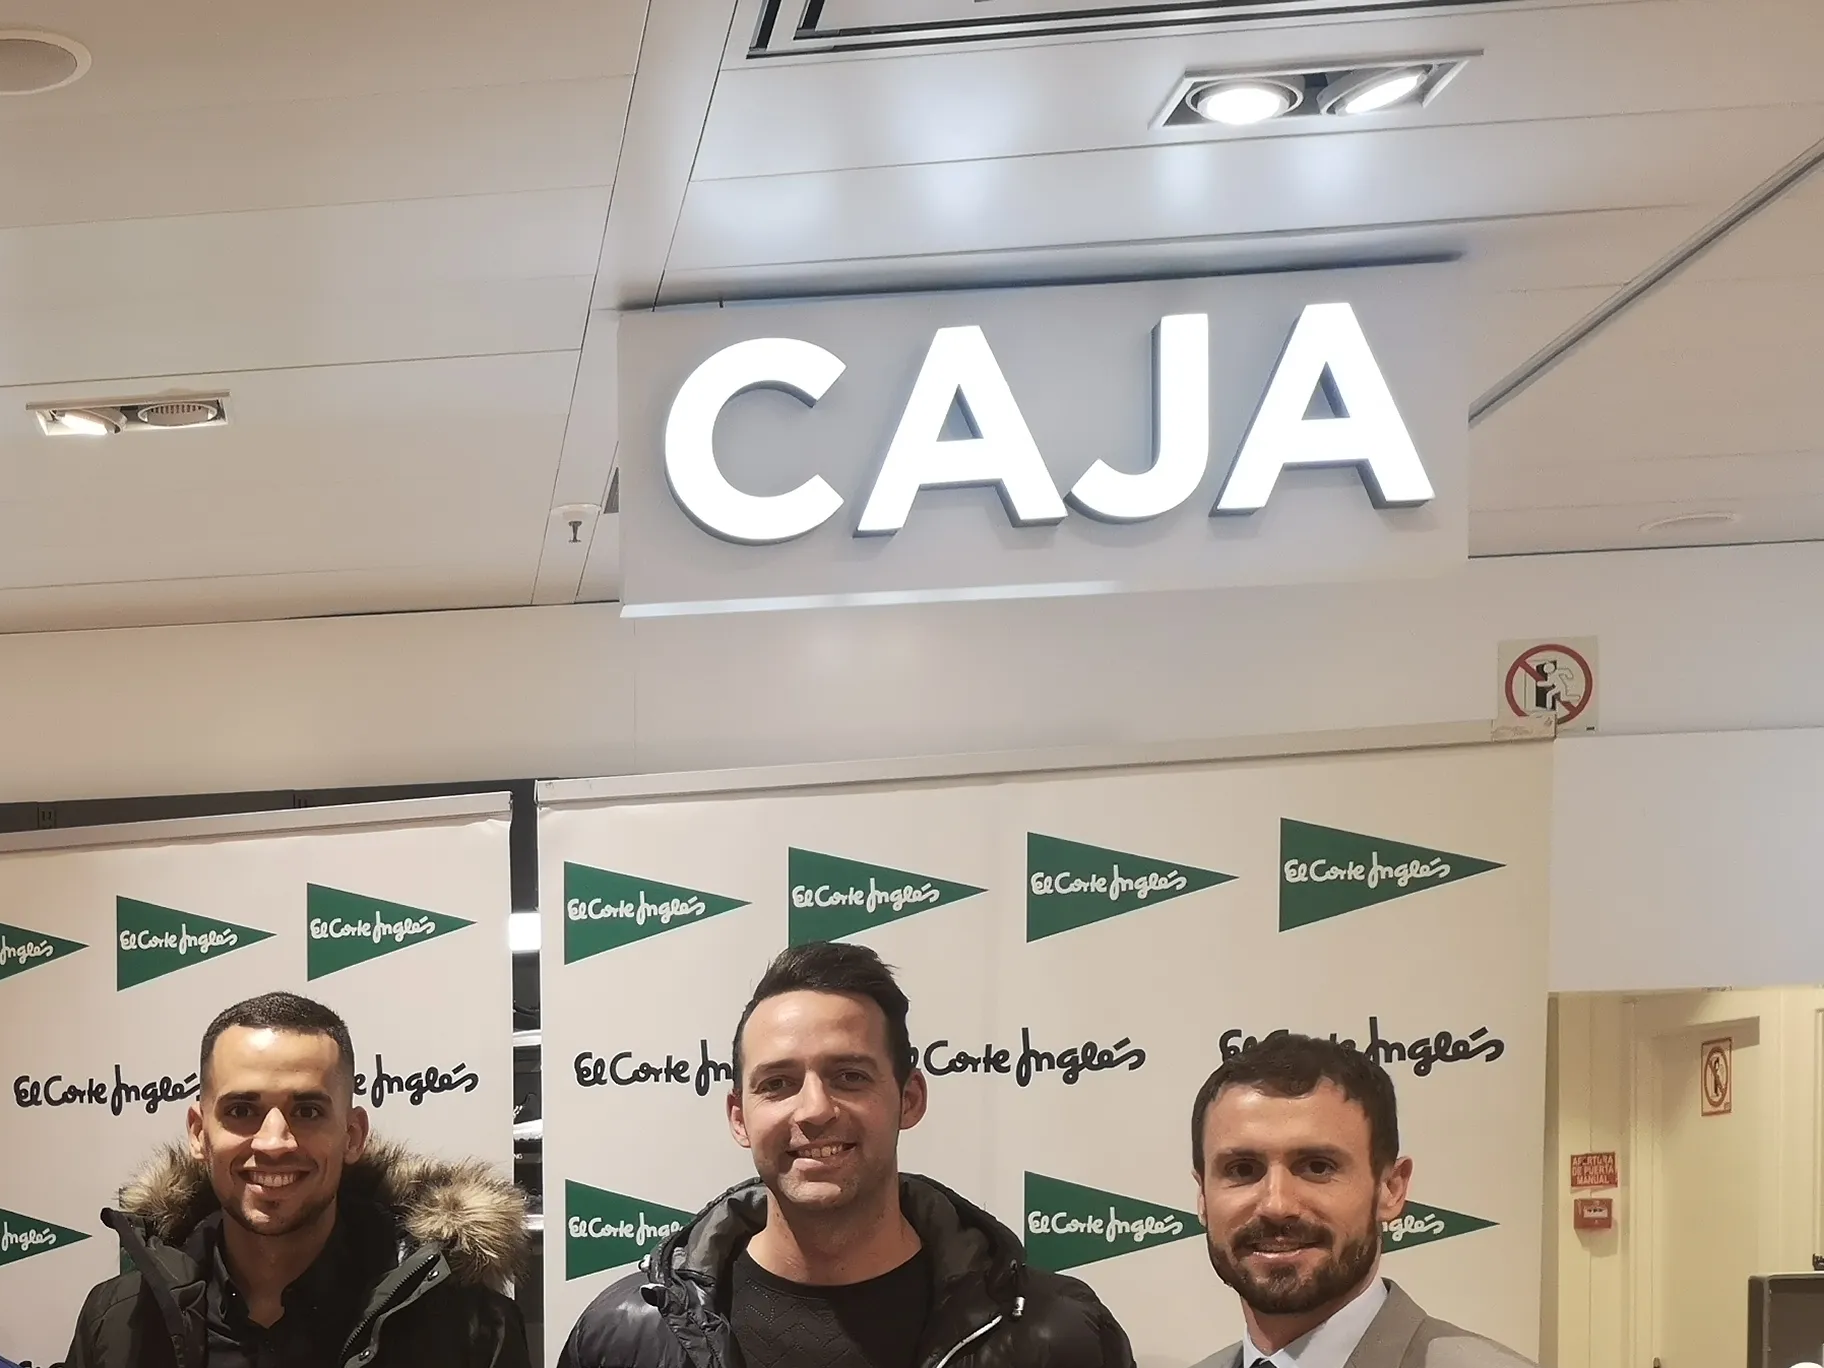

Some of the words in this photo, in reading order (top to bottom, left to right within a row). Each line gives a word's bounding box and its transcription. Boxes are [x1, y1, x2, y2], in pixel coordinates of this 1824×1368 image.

[664, 302, 1435, 544] CAJA
[1031, 871, 1053, 896] El
[1054, 870, 1107, 895] Corte
[1109, 864, 1187, 901] Inglés
[1284, 858, 1308, 884] El
[1309, 857, 1365, 882] Corte
[1367, 851, 1450, 888] Inglés
[567, 898, 587, 922] El
[588, 897, 635, 921] Corte
[636, 890, 706, 926] Inglés
[792, 885, 813, 909] El
[814, 883, 864, 908] Corte
[866, 877, 939, 914] Inglés
[120, 930, 138, 951] El
[138, 929, 177, 949] Corte
[178, 923, 239, 955] Inglés
[310, 918, 329, 940] El
[329, 917, 371, 938] Corte
[373, 911, 436, 944] Inglés
[0, 935, 53, 966] Inglés
[574, 1051, 607, 1087] El
[610, 1051, 690, 1087] Corte
[924, 1039, 1010, 1076] Corte
[1016, 1027, 1146, 1087] Inglés
[14, 1075, 42, 1109] El
[43, 1074, 108, 1106] Corte
[372, 1054, 478, 1118] Inglés
[1576, 1175, 1610, 1185] MANUAL
[1584, 1165, 1614, 1175] PUERTA
[1, 1222, 57, 1252] Inglés
[569, 1217, 588, 1239] El
[590, 1218, 633, 1240] Corte
[1028, 1211, 1049, 1234] El
[1051, 1211, 1104, 1234] Corte
[1106, 1206, 1183, 1243] Inglés
